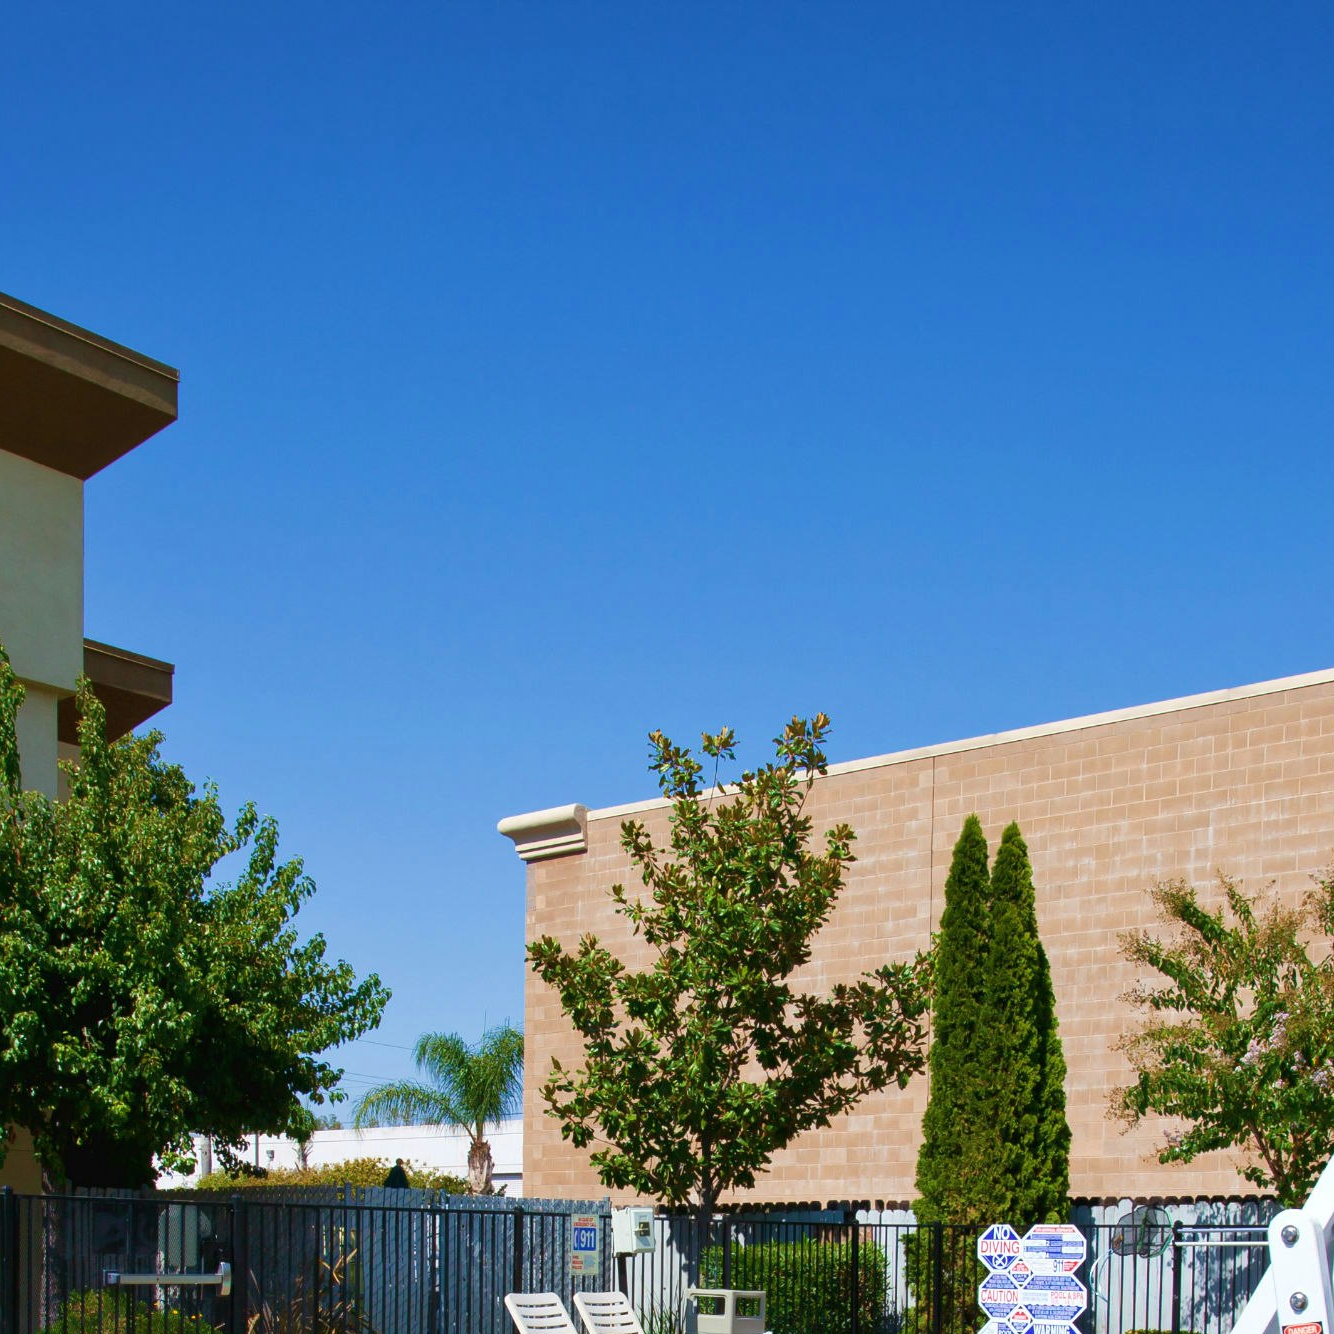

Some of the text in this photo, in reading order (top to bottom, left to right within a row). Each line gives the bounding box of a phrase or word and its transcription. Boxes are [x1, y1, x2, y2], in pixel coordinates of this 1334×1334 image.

[580, 1229, 595, 1248] 911
[993, 1226, 1010, 1240] NO
[980, 1240, 1020, 1254] DIVING
[1053, 1259, 1064, 1273] 911
[980, 1289, 1019, 1302] CAUTION
